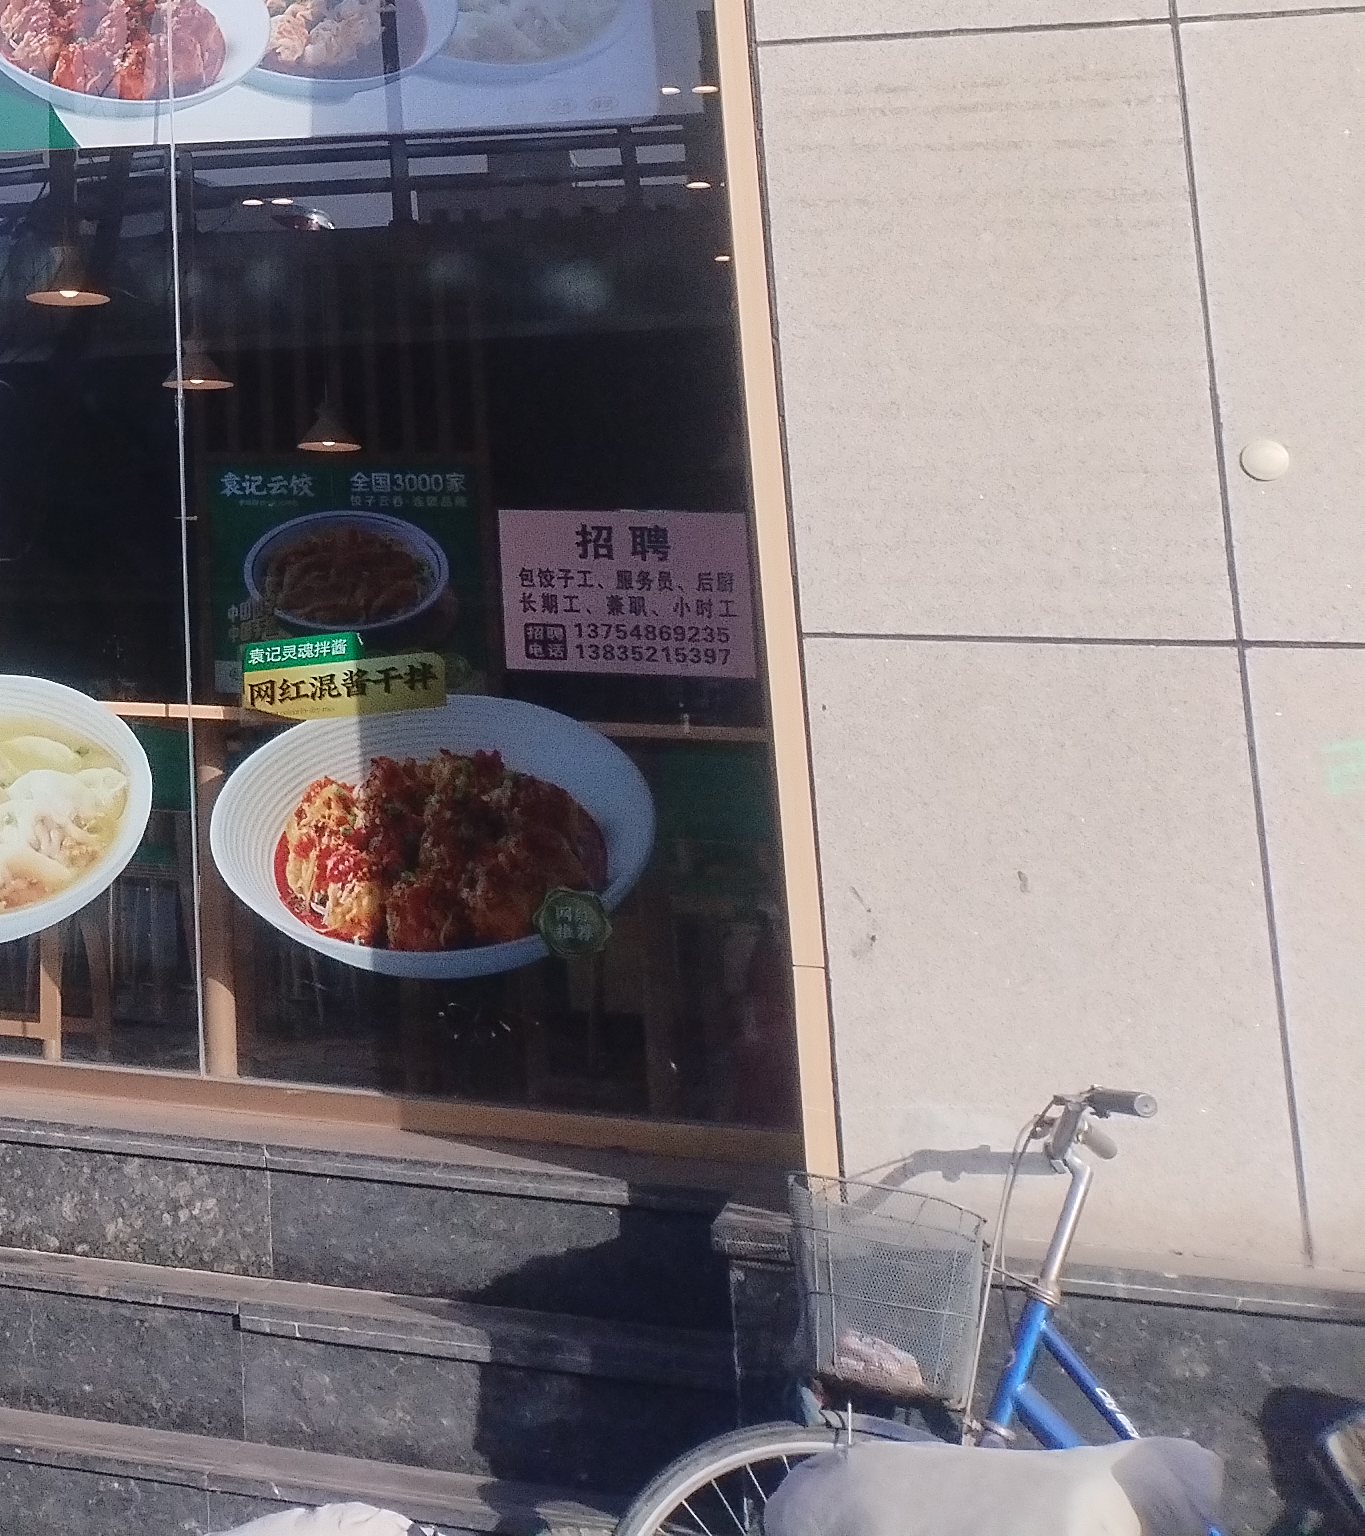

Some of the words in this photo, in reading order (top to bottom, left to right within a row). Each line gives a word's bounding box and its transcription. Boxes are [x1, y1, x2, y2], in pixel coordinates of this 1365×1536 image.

[219, 470, 316, 498] 袁记云饺
[349, 471, 467, 494] 全国3000家
[574, 523, 671, 563] 招聘
[573, 622, 731, 644] 13754869235
[248, 638, 348, 666] 袁记灵魂拌酱
[528, 643, 566, 659] 电话
[574, 643, 732, 666] 13835215397
[247, 661, 440, 707] 网红混酱干拌
